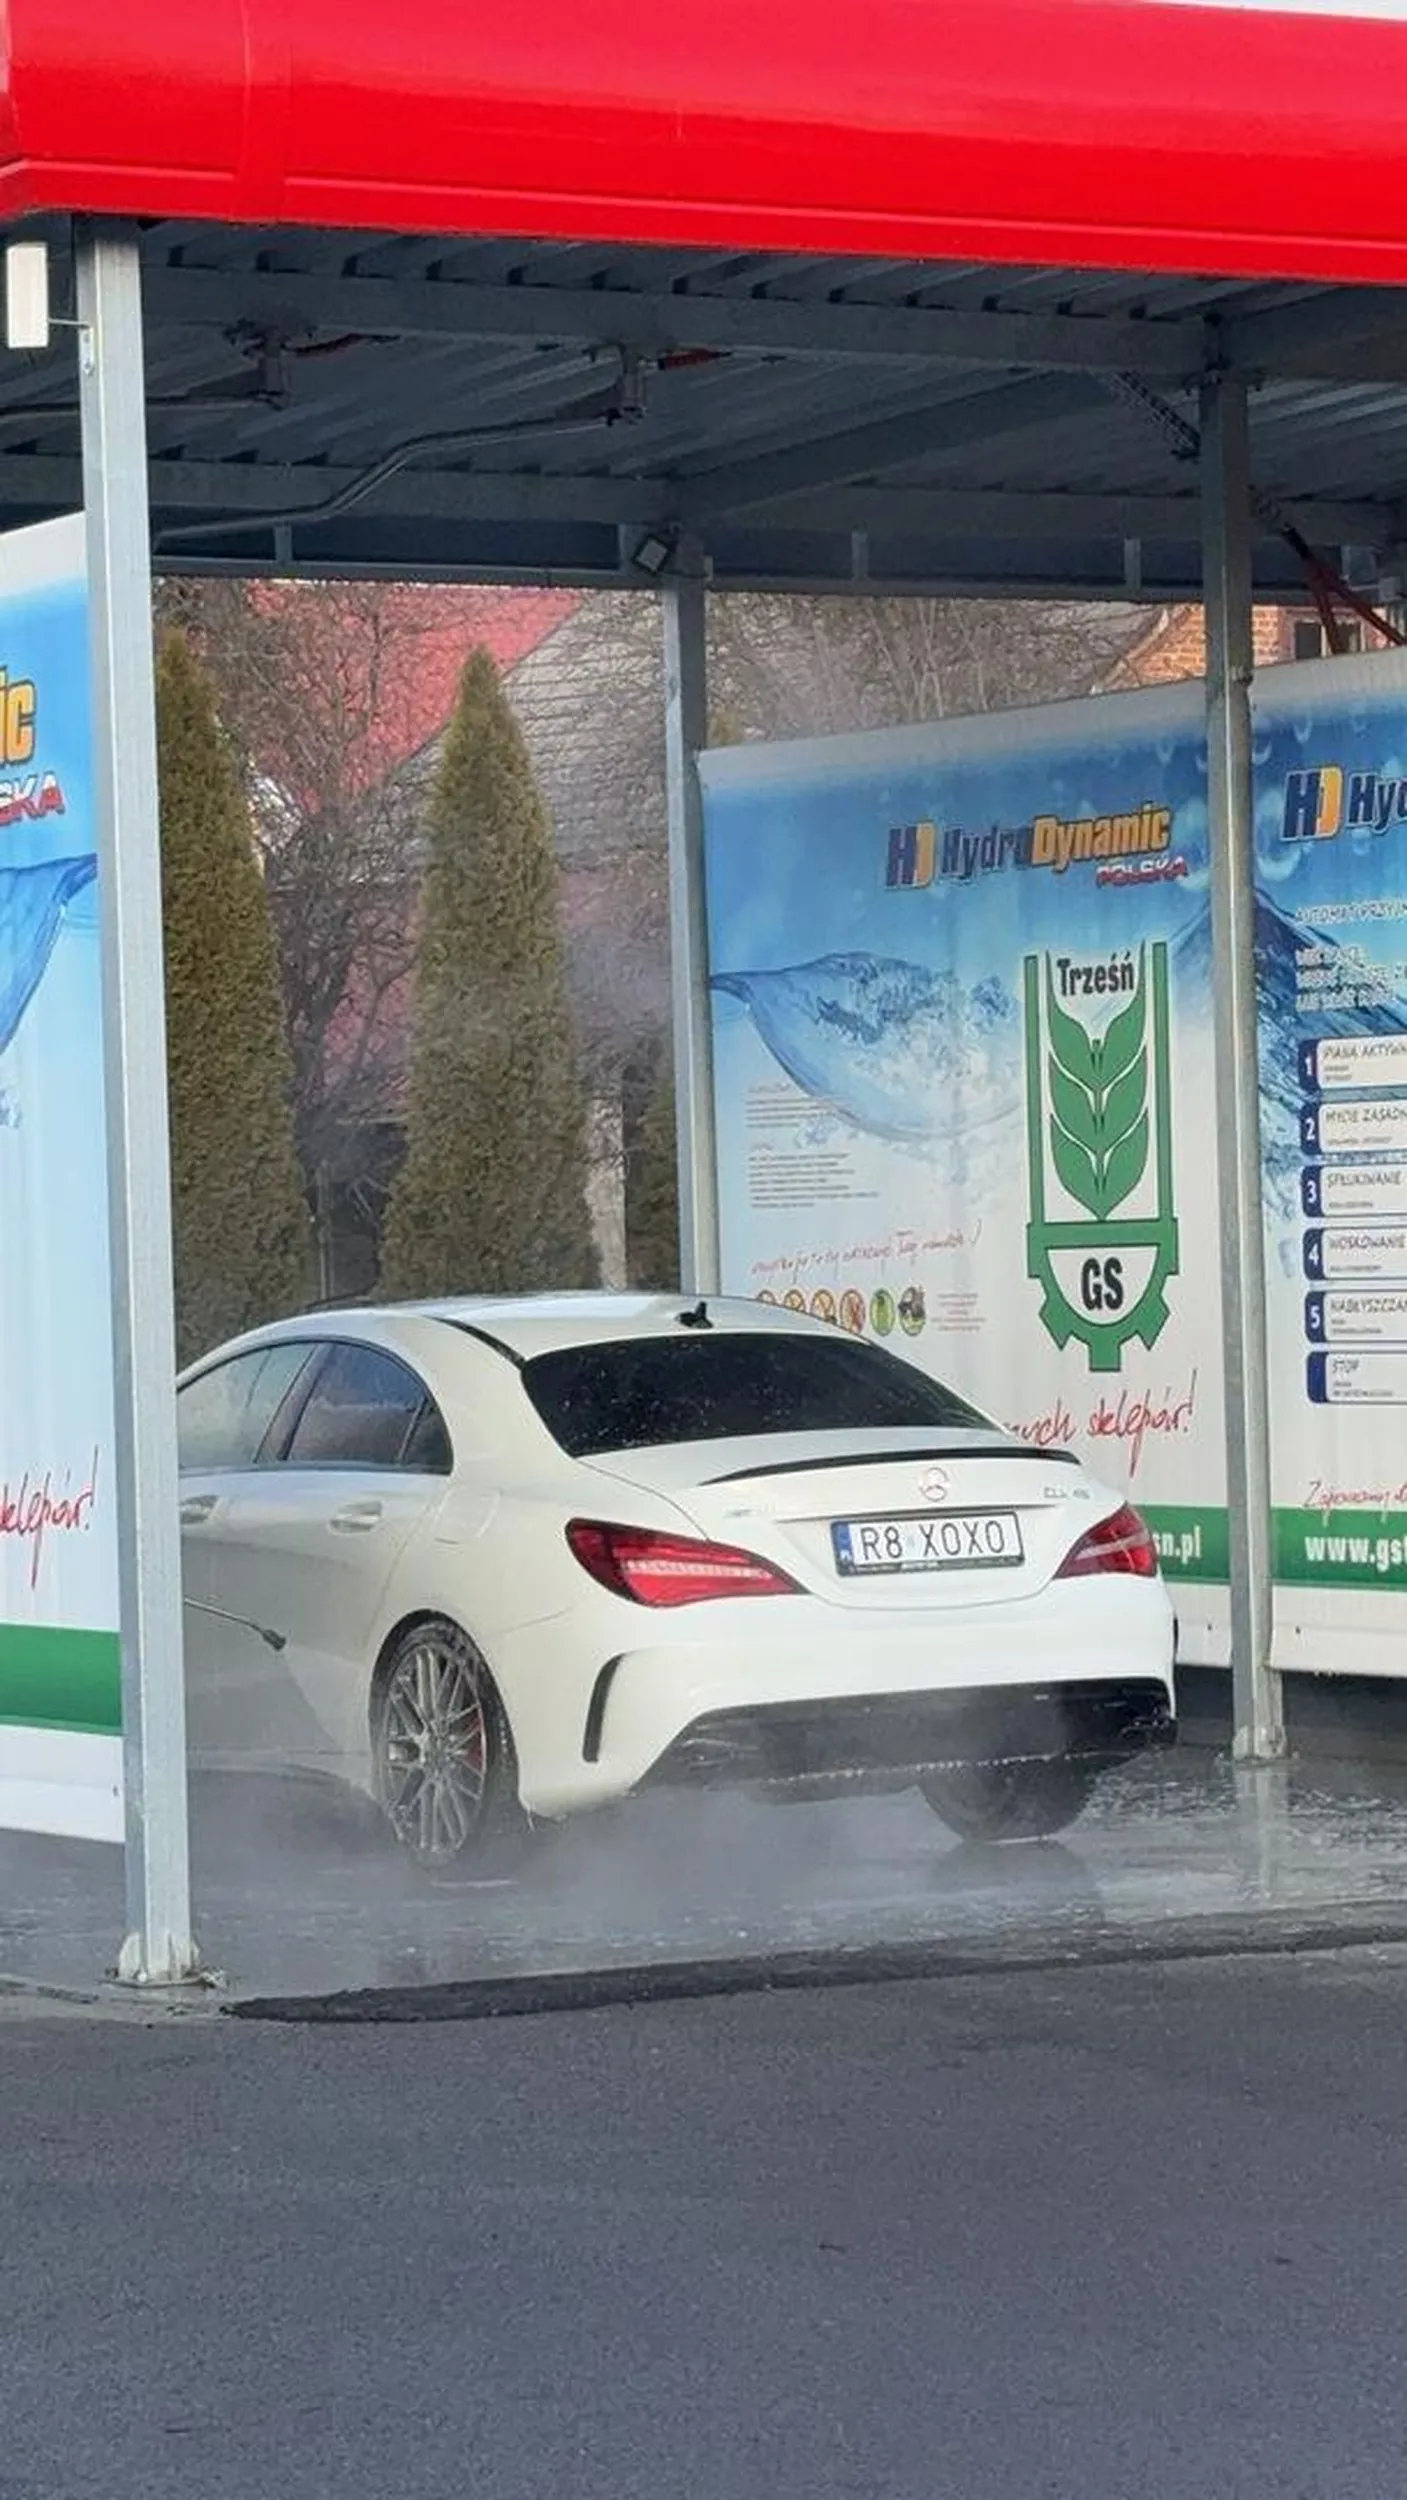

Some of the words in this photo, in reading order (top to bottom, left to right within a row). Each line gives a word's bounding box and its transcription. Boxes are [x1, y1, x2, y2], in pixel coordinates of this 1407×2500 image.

[1281, 765, 1342, 841] HD
[941, 801, 1172, 879] HydroDynamic
[1096, 856, 1190, 888] POLSKA
[1056, 950, 1134, 997] Trześń
[1304, 1054, 1314, 1077] 1
[1305, 1117, 1316, 1141] 2
[1307, 1180, 1318, 1204] 3
[1308, 1241, 1320, 1266] 4
[1081, 1257, 1124, 1311] GS
[1310, 1304, 1321, 1329] 5
[0, 1444, 99, 1590] klepów!
[859, 1526, 903, 1561] R8
[919, 1520, 1006, 1557] XOXO
